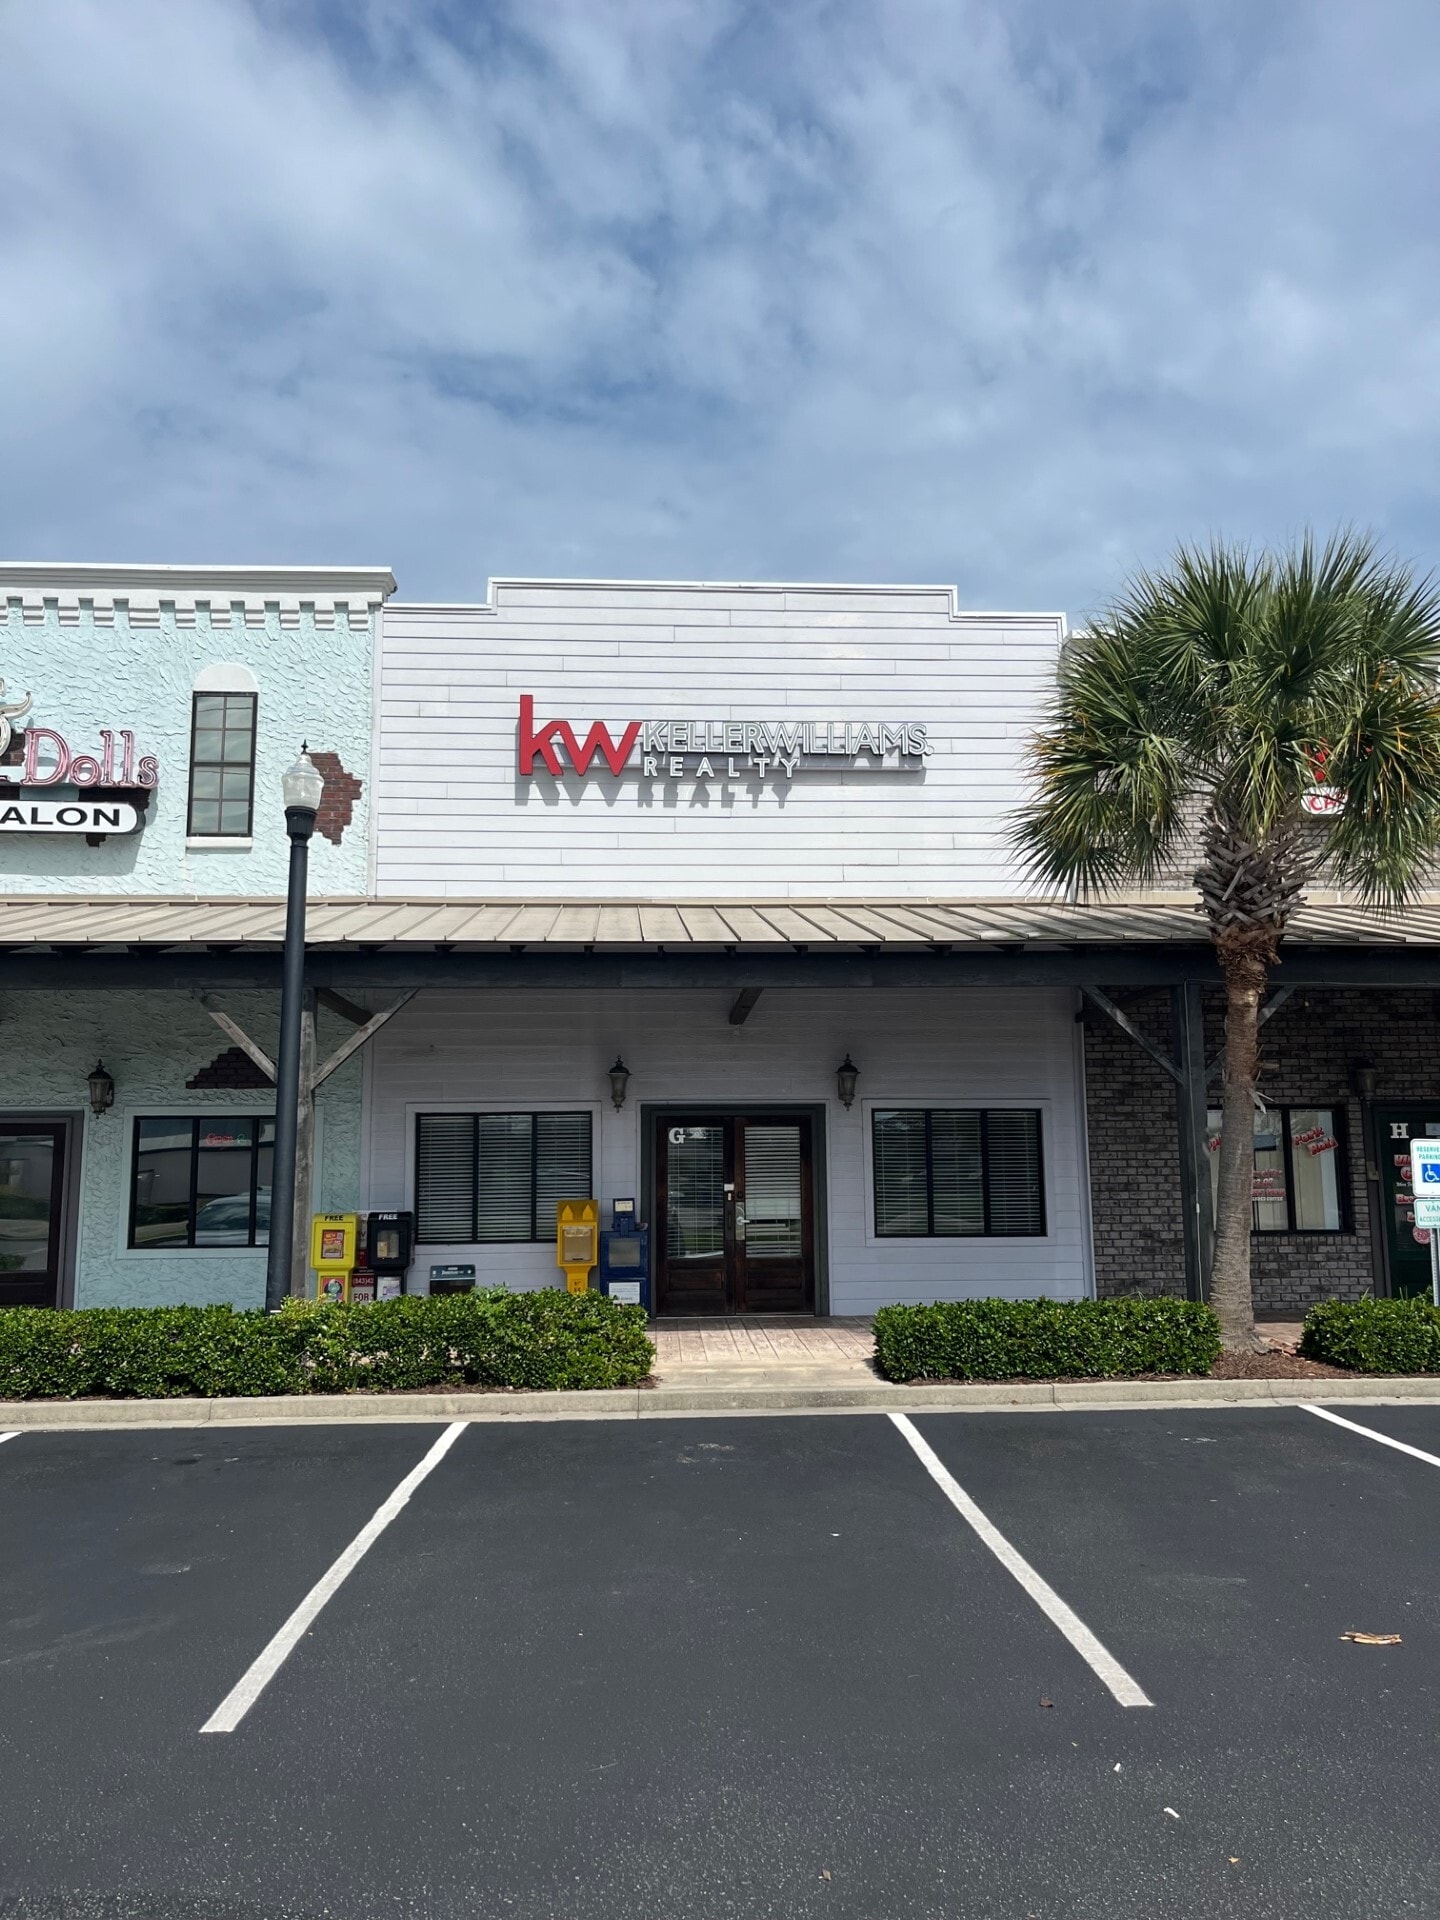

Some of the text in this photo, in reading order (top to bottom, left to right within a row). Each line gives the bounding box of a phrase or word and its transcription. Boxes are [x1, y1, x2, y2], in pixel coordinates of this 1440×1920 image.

[20, 728, 159, 788] Dolls
[643, 756, 799, 778] REALTY
[668, 1127, 686, 1144] G
[1389, 1122, 1409, 1139] H
[353, 1293, 369, 1302] FOR
